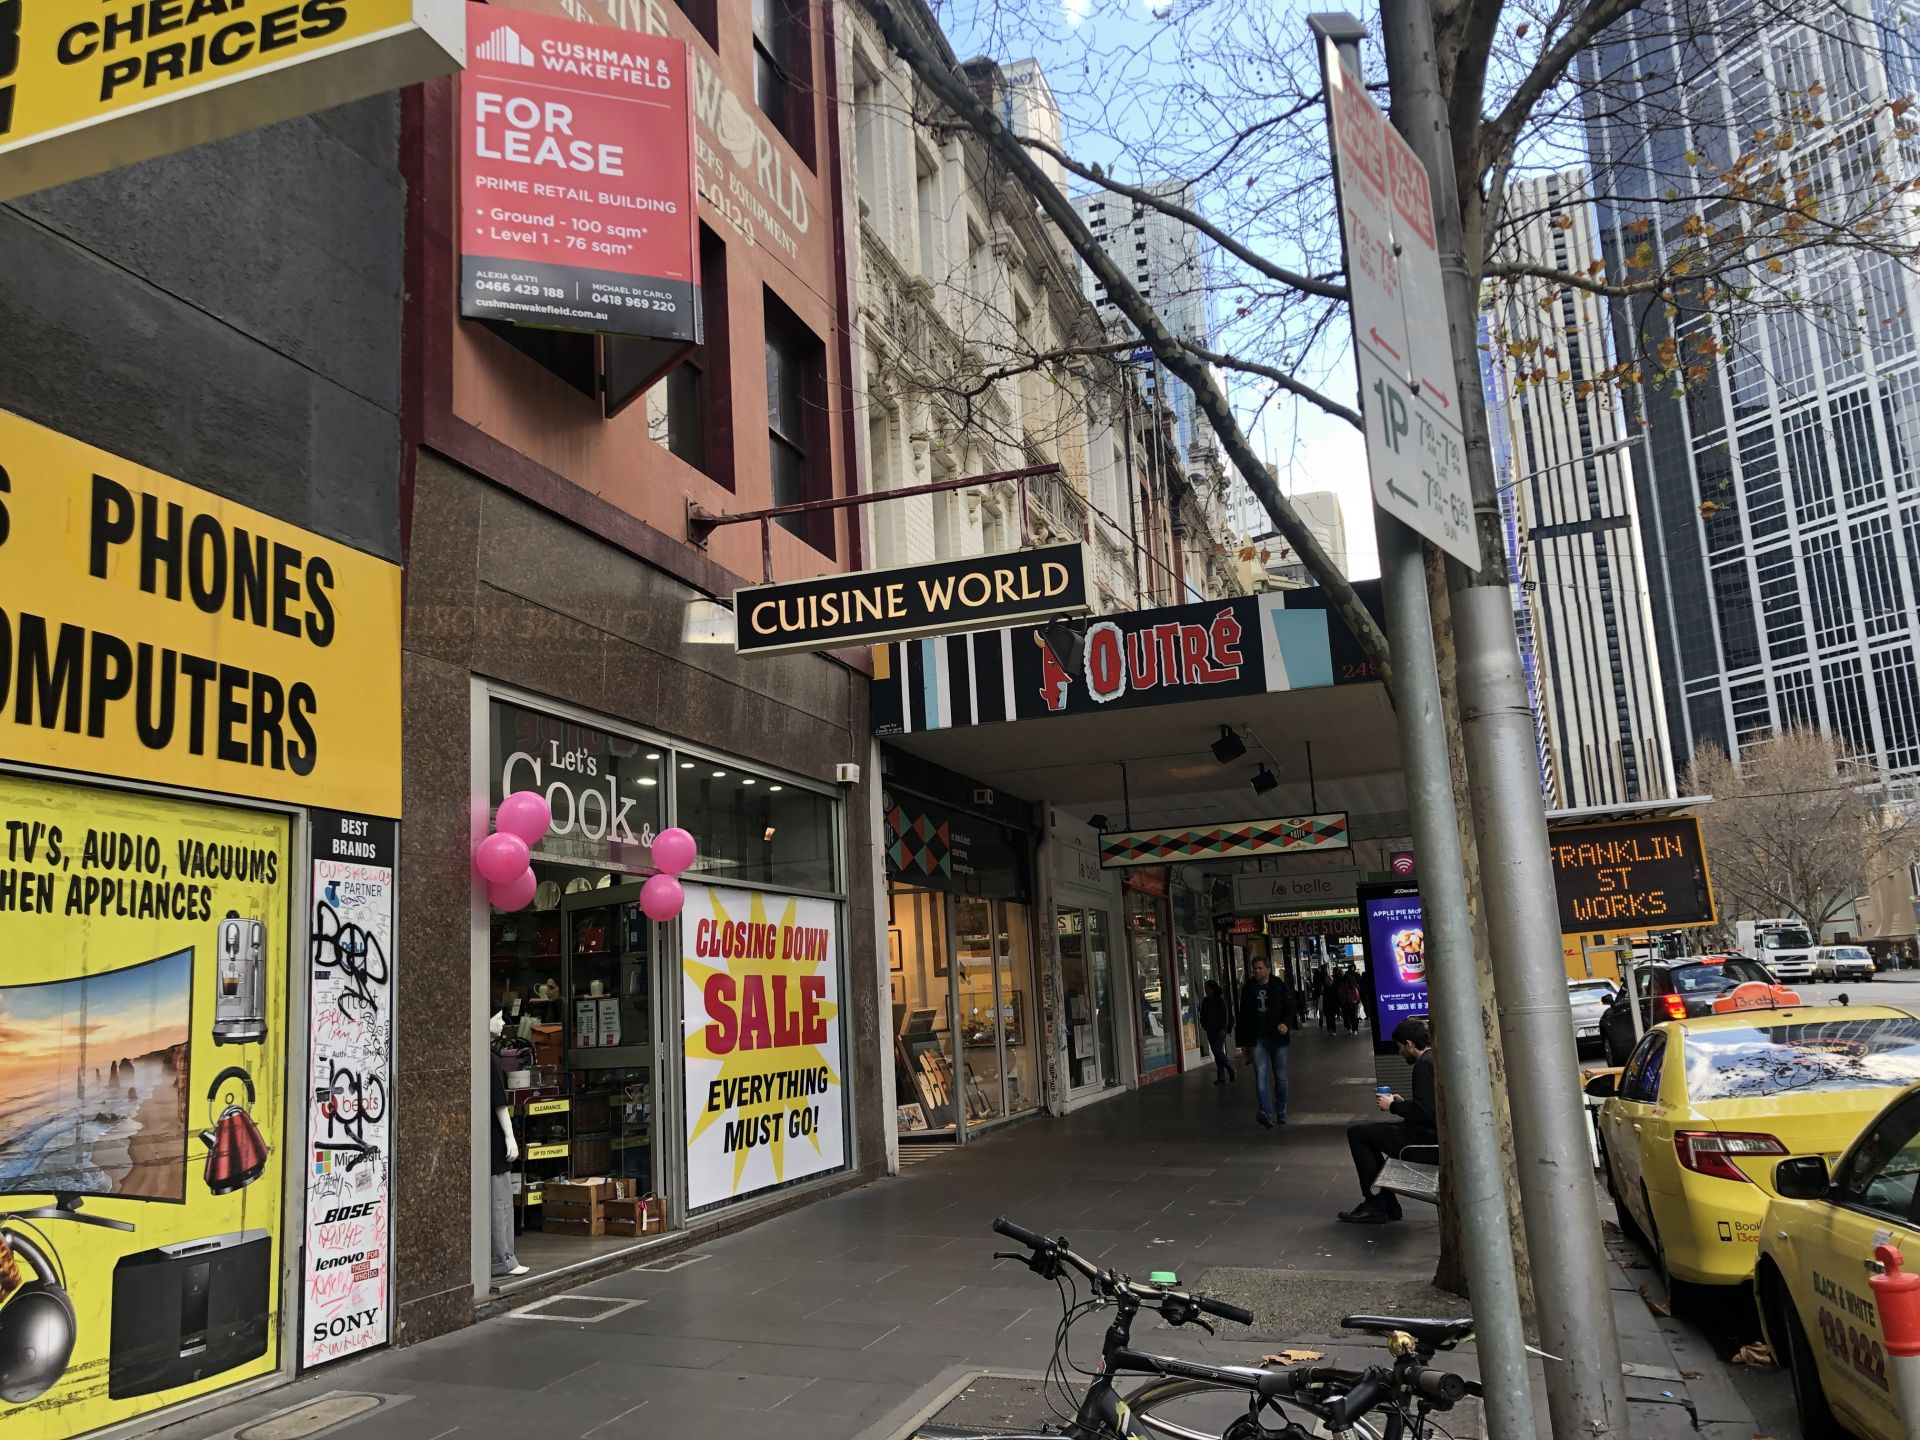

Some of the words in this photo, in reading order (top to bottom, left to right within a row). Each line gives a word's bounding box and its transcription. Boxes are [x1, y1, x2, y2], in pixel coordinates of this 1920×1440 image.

[100, 0, 347, 101] PRICES
[541, 39, 650, 69] CUSHMAN
[656, 59, 670, 74] &
[541, 55, 671, 89] WAKEFIELD
[476, 91, 573, 135] FOR
[476, 126, 623, 176] LEASE
[475, 175, 528, 194] PRIME
[534, 184, 593, 203] RETAIL
[599, 192, 677, 214] BUILDING
[490, 208, 554, 228] Ground
[571, 218, 601, 235] 100
[729, 171, 798, 260] EQUIPMENT
[490, 227, 536, 245] Level
[542, 232, 549, 245] 1
[566, 236, 587, 251] 76
[475, 280, 511, 293] 0466
[514, 284, 539, 296] 429
[543, 287, 564, 299] 188
[476, 270, 508, 281] ALEXIA
[511, 274, 538, 283] GATTI
[592, 283, 630, 295] MICHAEL
[632, 288, 642, 296] DI
[643, 289, 673, 300] CARLO
[592, 293, 622, 306] 0418
[626, 297, 649, 309] 969
[652, 301, 676, 312] 220
[475, 298, 609, 320] cushmanwakefield.com.au
[1373, 376, 1409, 455] 1P
[89, 473, 335, 648] PHONES
[751, 584, 906, 636] CUISINE
[918, 562, 1069, 613] WORLD
[1525, 582, 1535, 590] 23
[550, 740, 597, 777] Let's
[341, 818, 369, 837] BEST
[6, 820, 70, 872] TV'S,
[82, 829, 168, 879] AUDIO,
[178, 838, 278, 885] VACUUMS
[332, 839, 376, 860] BRANDS
[344, 881, 382, 897] PARTNER
[1271, 881, 1286, 896] la
[1292, 878, 1332, 893] belle
[1598, 867, 1632, 892] ST
[65, 873, 212, 923] APPLIANCES
[1573, 891, 1667, 921] WORKS
[1373, 909, 1395, 917] APPLE
[1396, 909, 1407, 917] PIE
[696, 917, 776, 960] CLOSING
[782, 924, 828, 961] DOWN
[1269, 922, 1320, 937] LUGGAGE
[703, 973, 828, 1055] SALE
[1733, 996, 1780, 1008] 13cabs
[707, 1066, 828, 1113] EVERYTHING
[534, 1103, 562, 1112] CLEARANCE
[723, 1112, 783, 1154] MUST
[788, 1105, 819, 1139] GO!
[318, 1202, 378, 1225] BOSE
[315, 1252, 365, 1272] lenovo
[352, 1262, 370, 1273] THOSE
[367, 1250, 379, 1259] FOR
[354, 1272, 368, 1282] WHO
[1812, 1270, 1838, 1305] BLACK
[1846, 1290, 1876, 1329] WHITE
[313, 1308, 379, 1343] SONY
[1819, 1306, 1849, 1364] 133
[1849, 1325, 1889, 1393] 222
